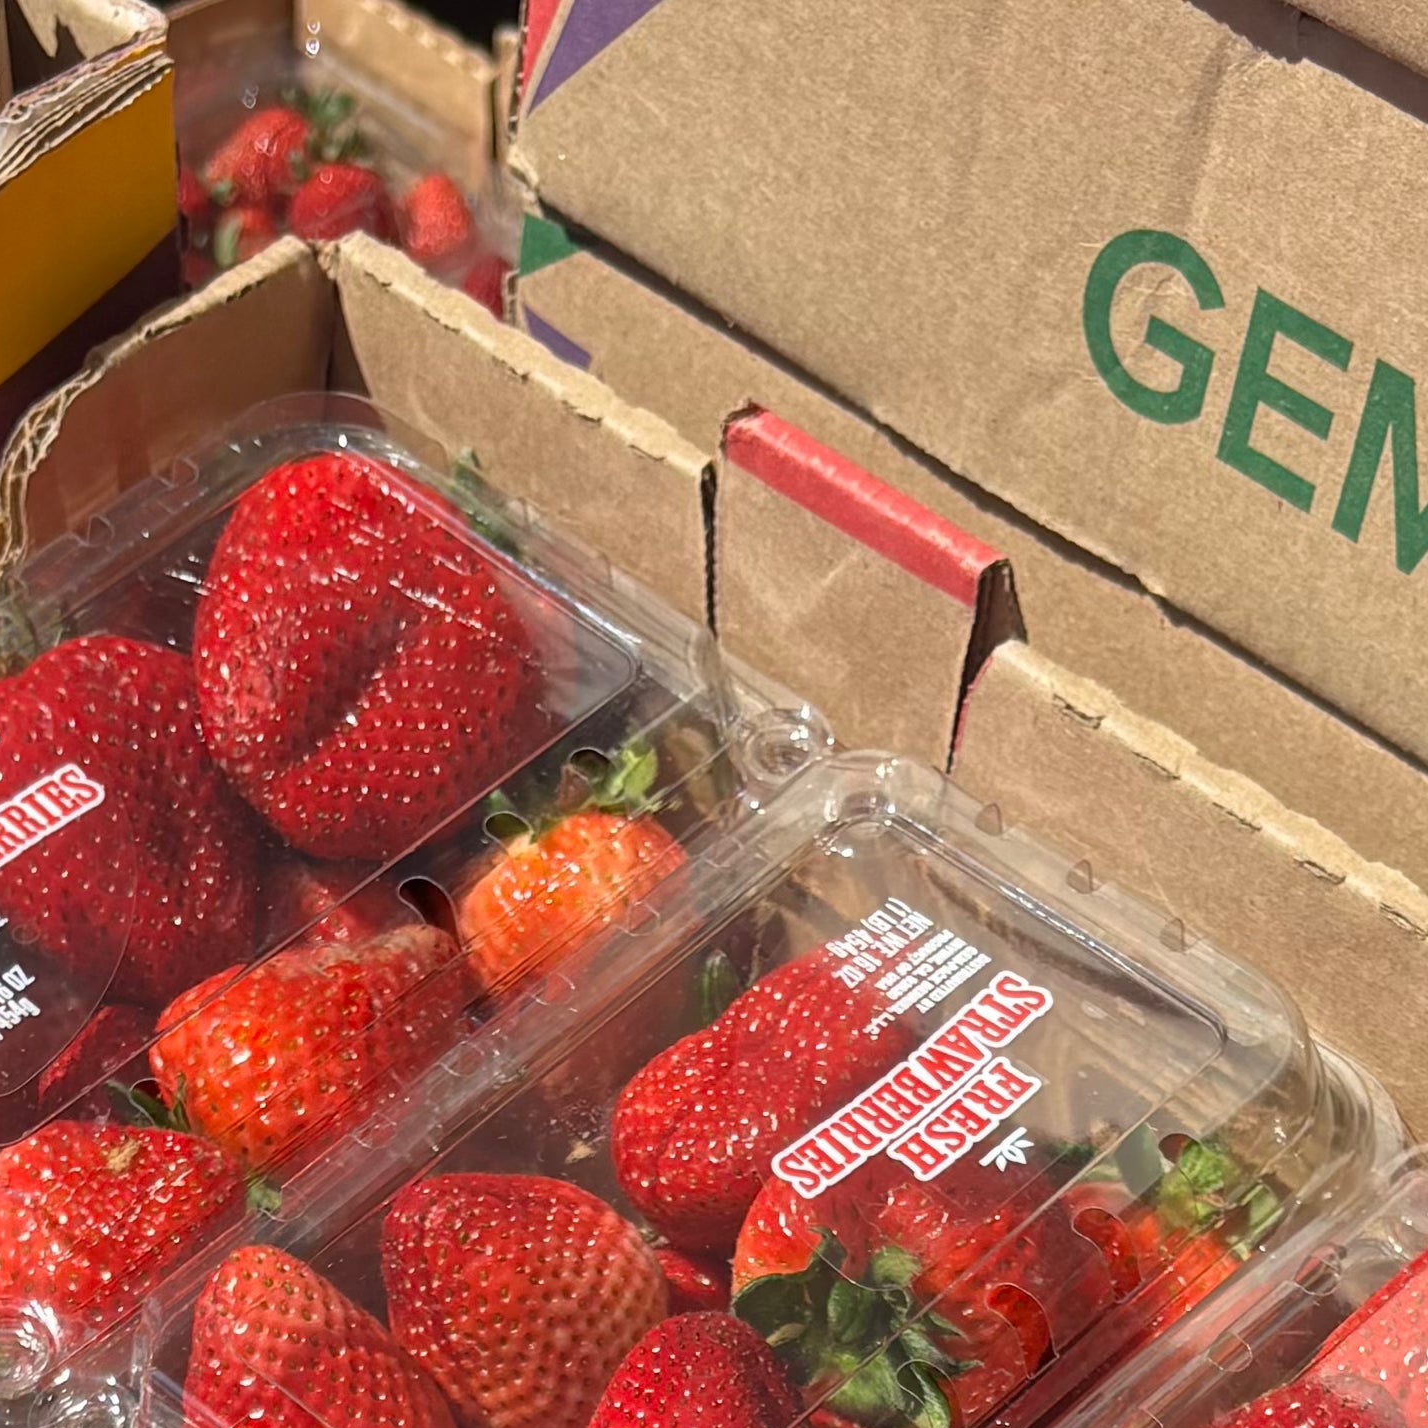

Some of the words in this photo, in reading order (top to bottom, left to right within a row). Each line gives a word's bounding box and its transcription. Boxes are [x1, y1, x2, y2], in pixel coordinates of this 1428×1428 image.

[893, 909, 934, 940] NET
[1, 961, 37, 992] OZ
[832, 961, 867, 989] OZ
[852, 948, 884, 974] 16
[776, 972, 1046, 1192] STRAWBERRIES
[892, 1060, 1037, 1177] FRESH
